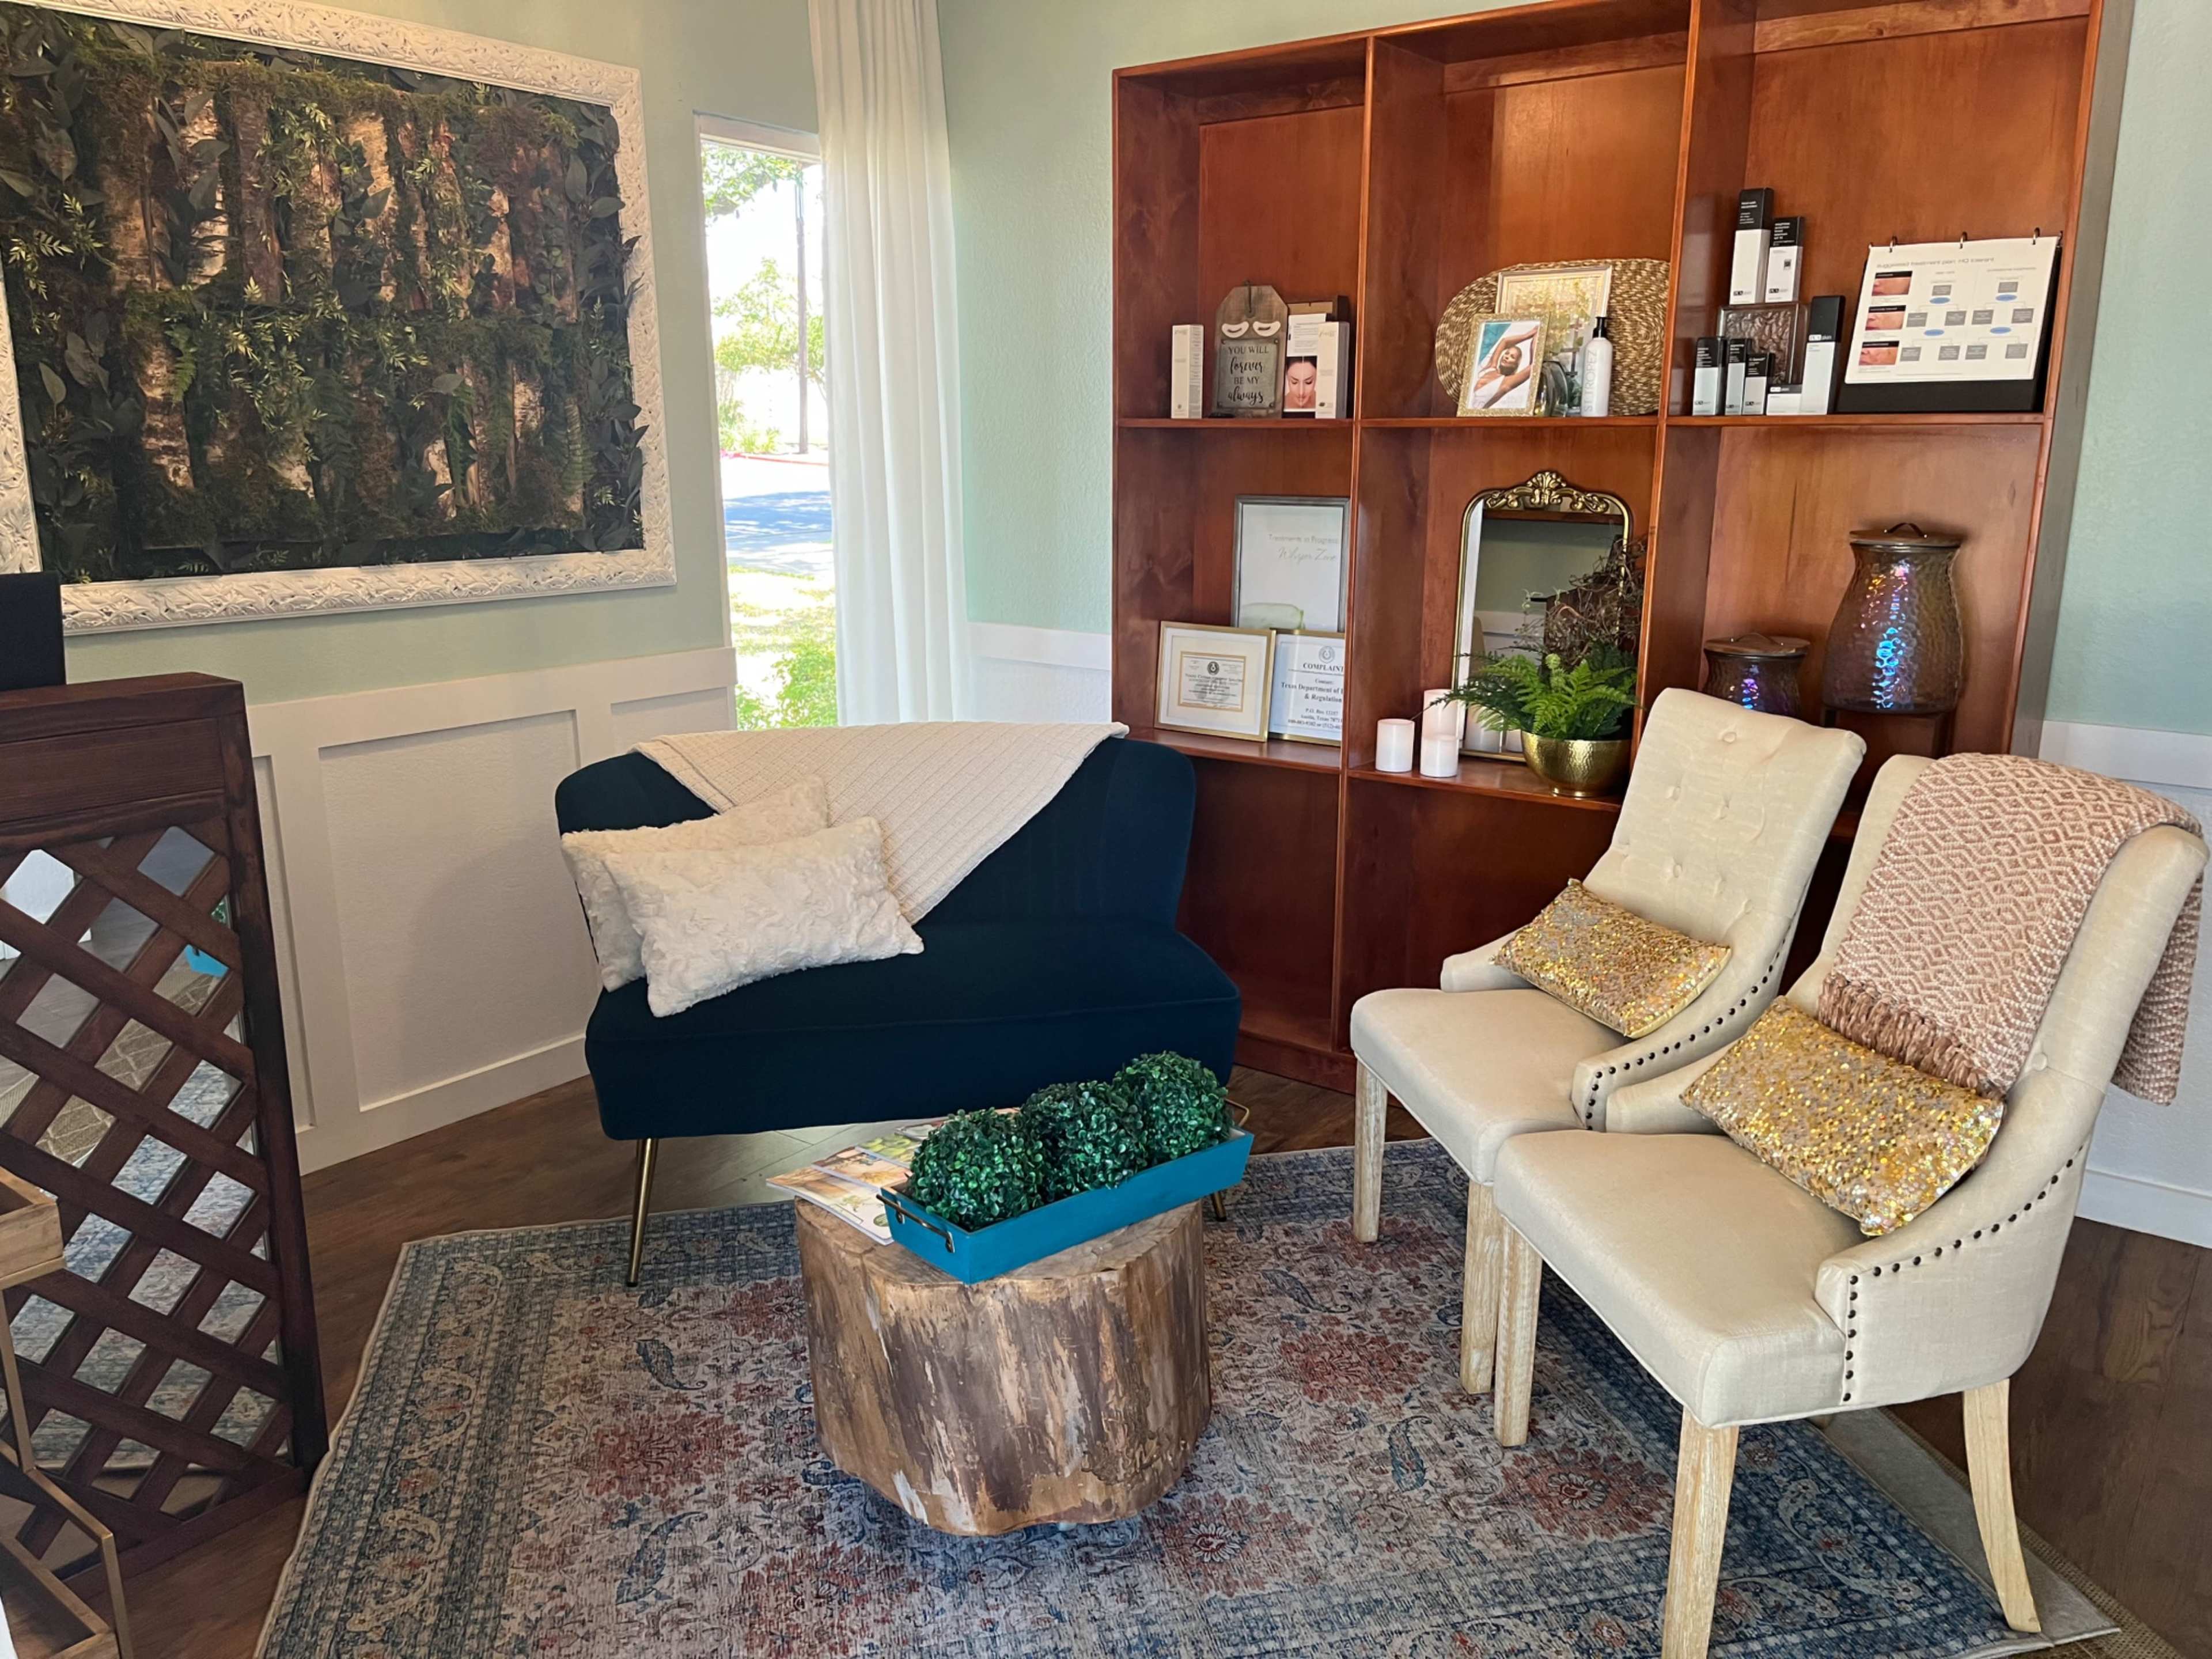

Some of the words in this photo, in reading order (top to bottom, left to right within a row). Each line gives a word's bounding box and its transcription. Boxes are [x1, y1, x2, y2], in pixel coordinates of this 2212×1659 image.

[1228, 346, 1245, 354] YOU
[1248, 346, 1269, 354] WILL
[1230, 356, 1263, 374] forever
[1234, 376, 1245, 385] BE
[1247, 376, 1260, 384] MY
[1228, 385, 1264, 406] always
[1281, 681, 1297, 690] Texas
[1298, 683, 1332, 692] Department
[1311, 694, 1342, 703] Regulation
